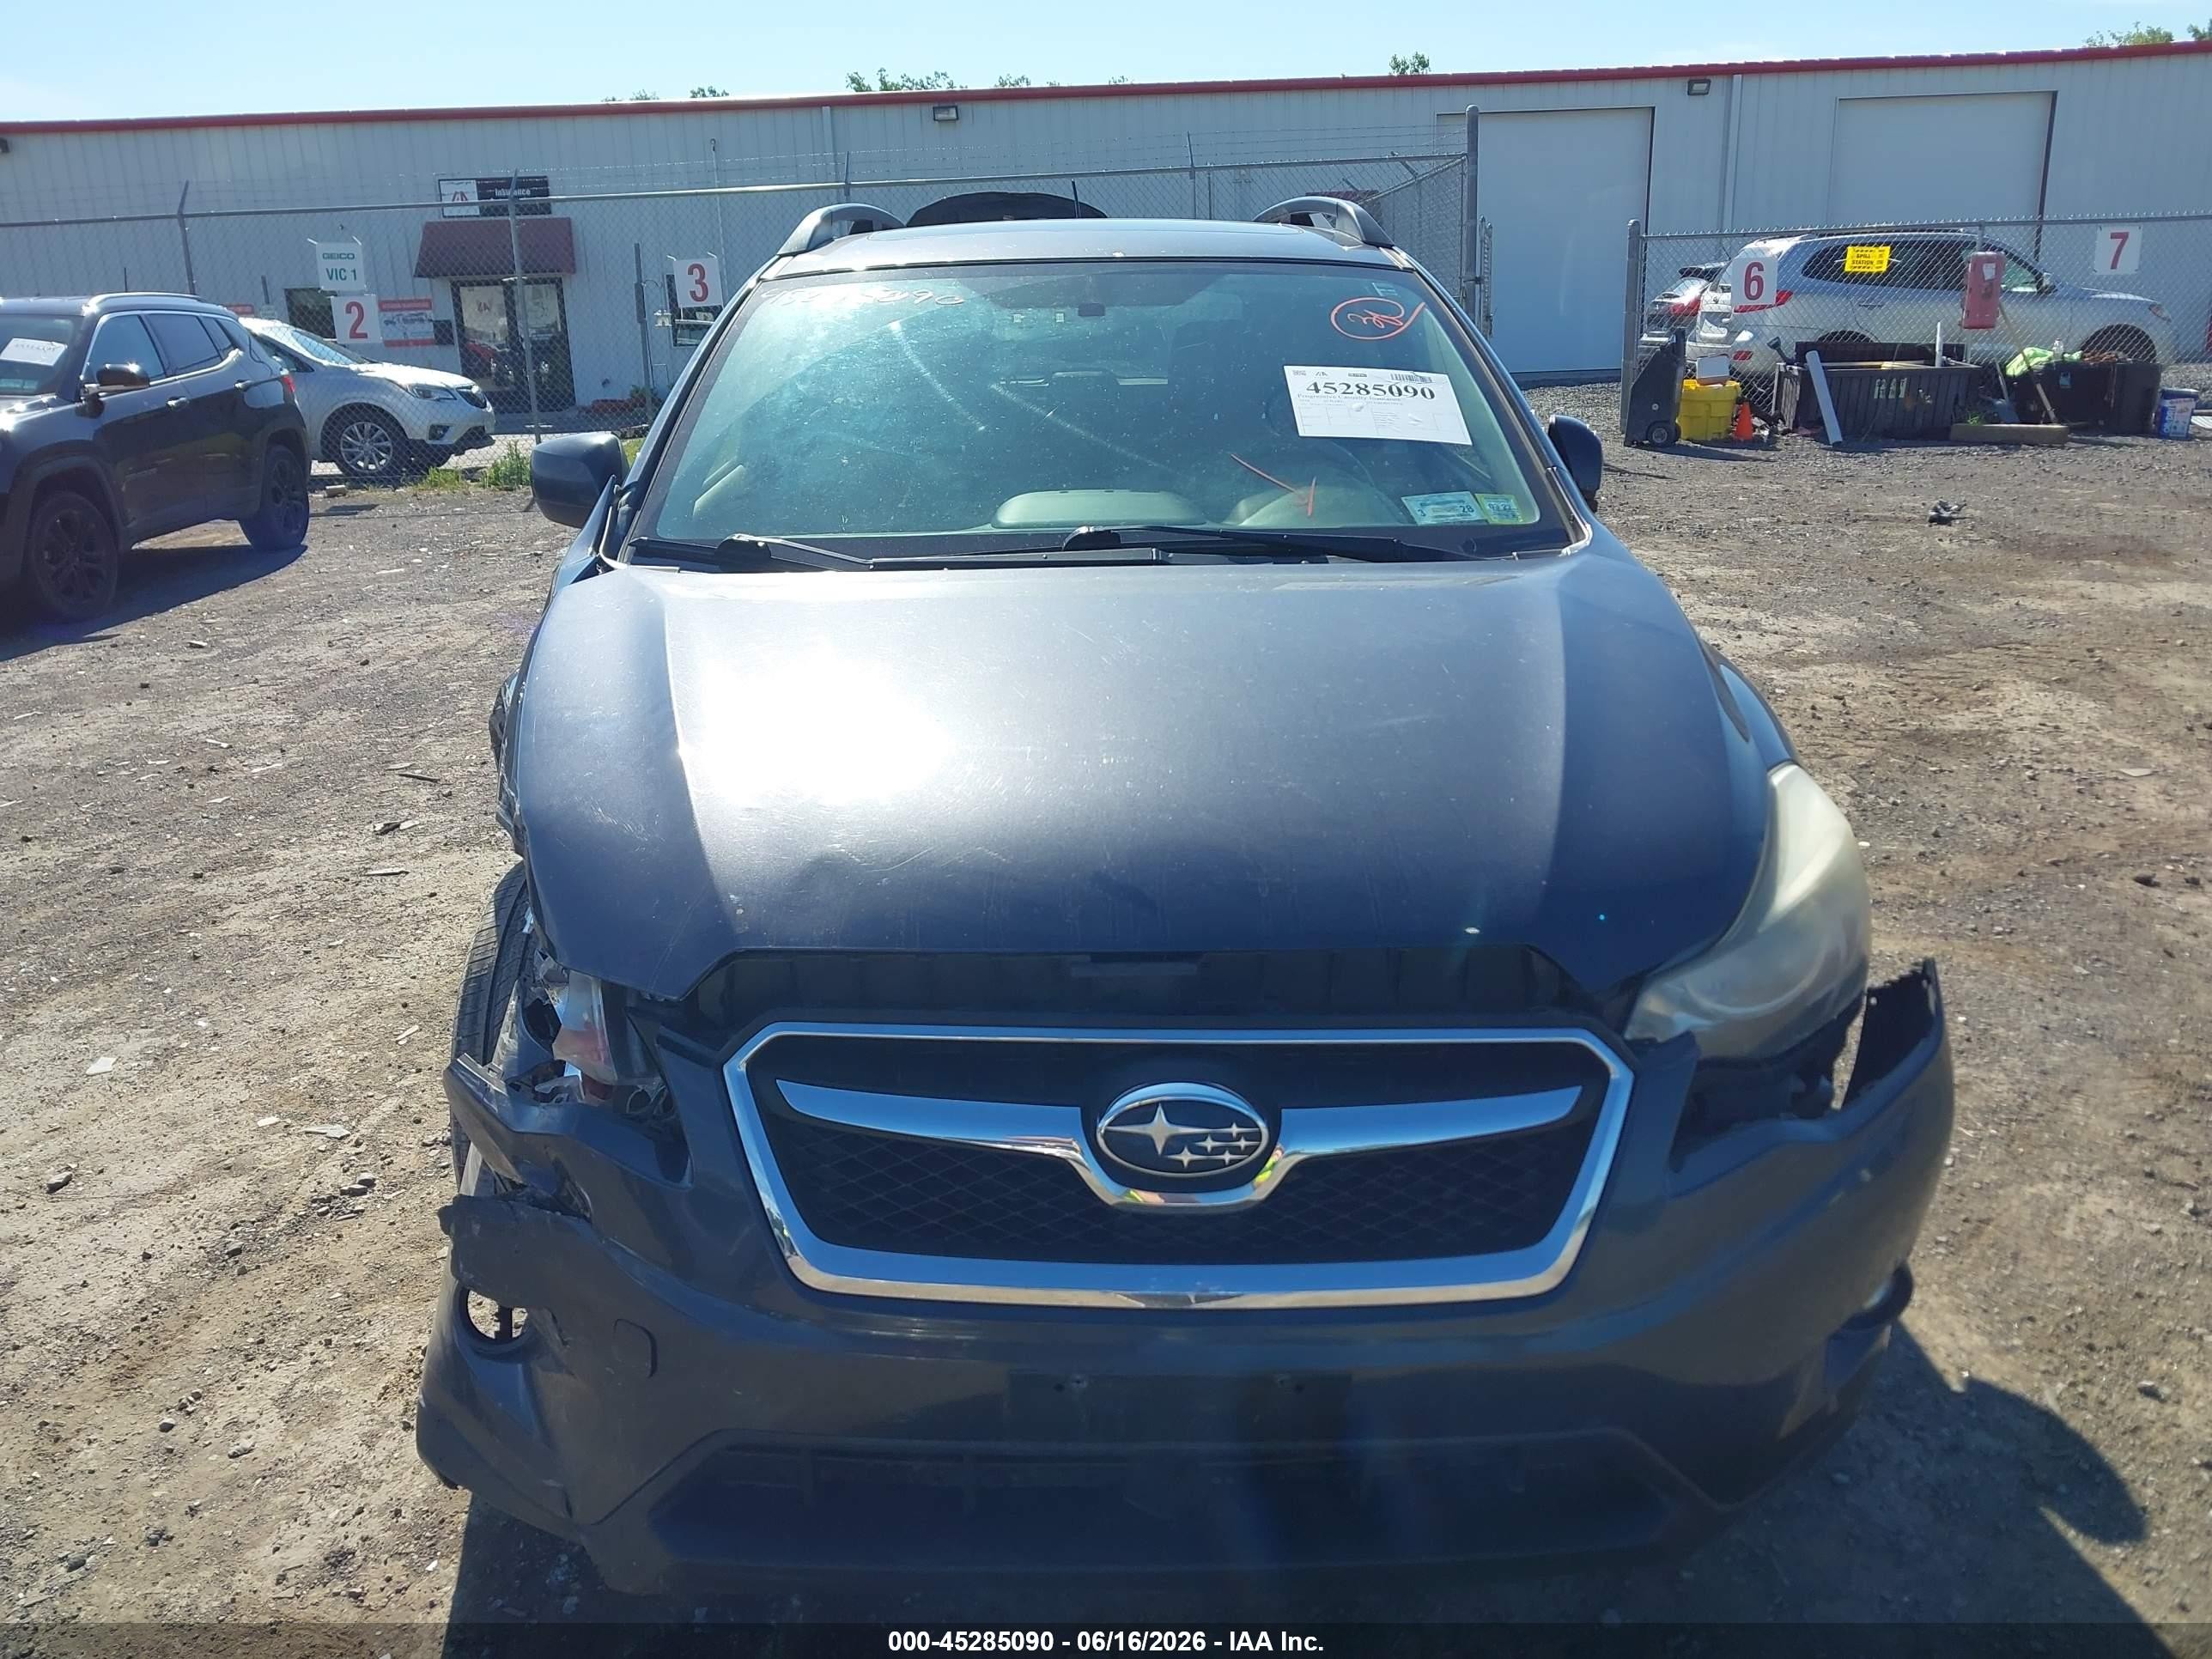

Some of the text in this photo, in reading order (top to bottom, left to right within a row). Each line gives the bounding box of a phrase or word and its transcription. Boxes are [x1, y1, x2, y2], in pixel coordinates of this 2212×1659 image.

[495, 187, 531, 197] Insuance
[2110, 231, 2130, 270] 7
[325, 268, 357, 281] VIC 1
[687, 263, 708, 302] 3
[1744, 261, 1765, 301] 6
[345, 301, 368, 339] 2
[1305, 380, 1436, 401] 45285090
[1460, 504, 1474, 514] 28
